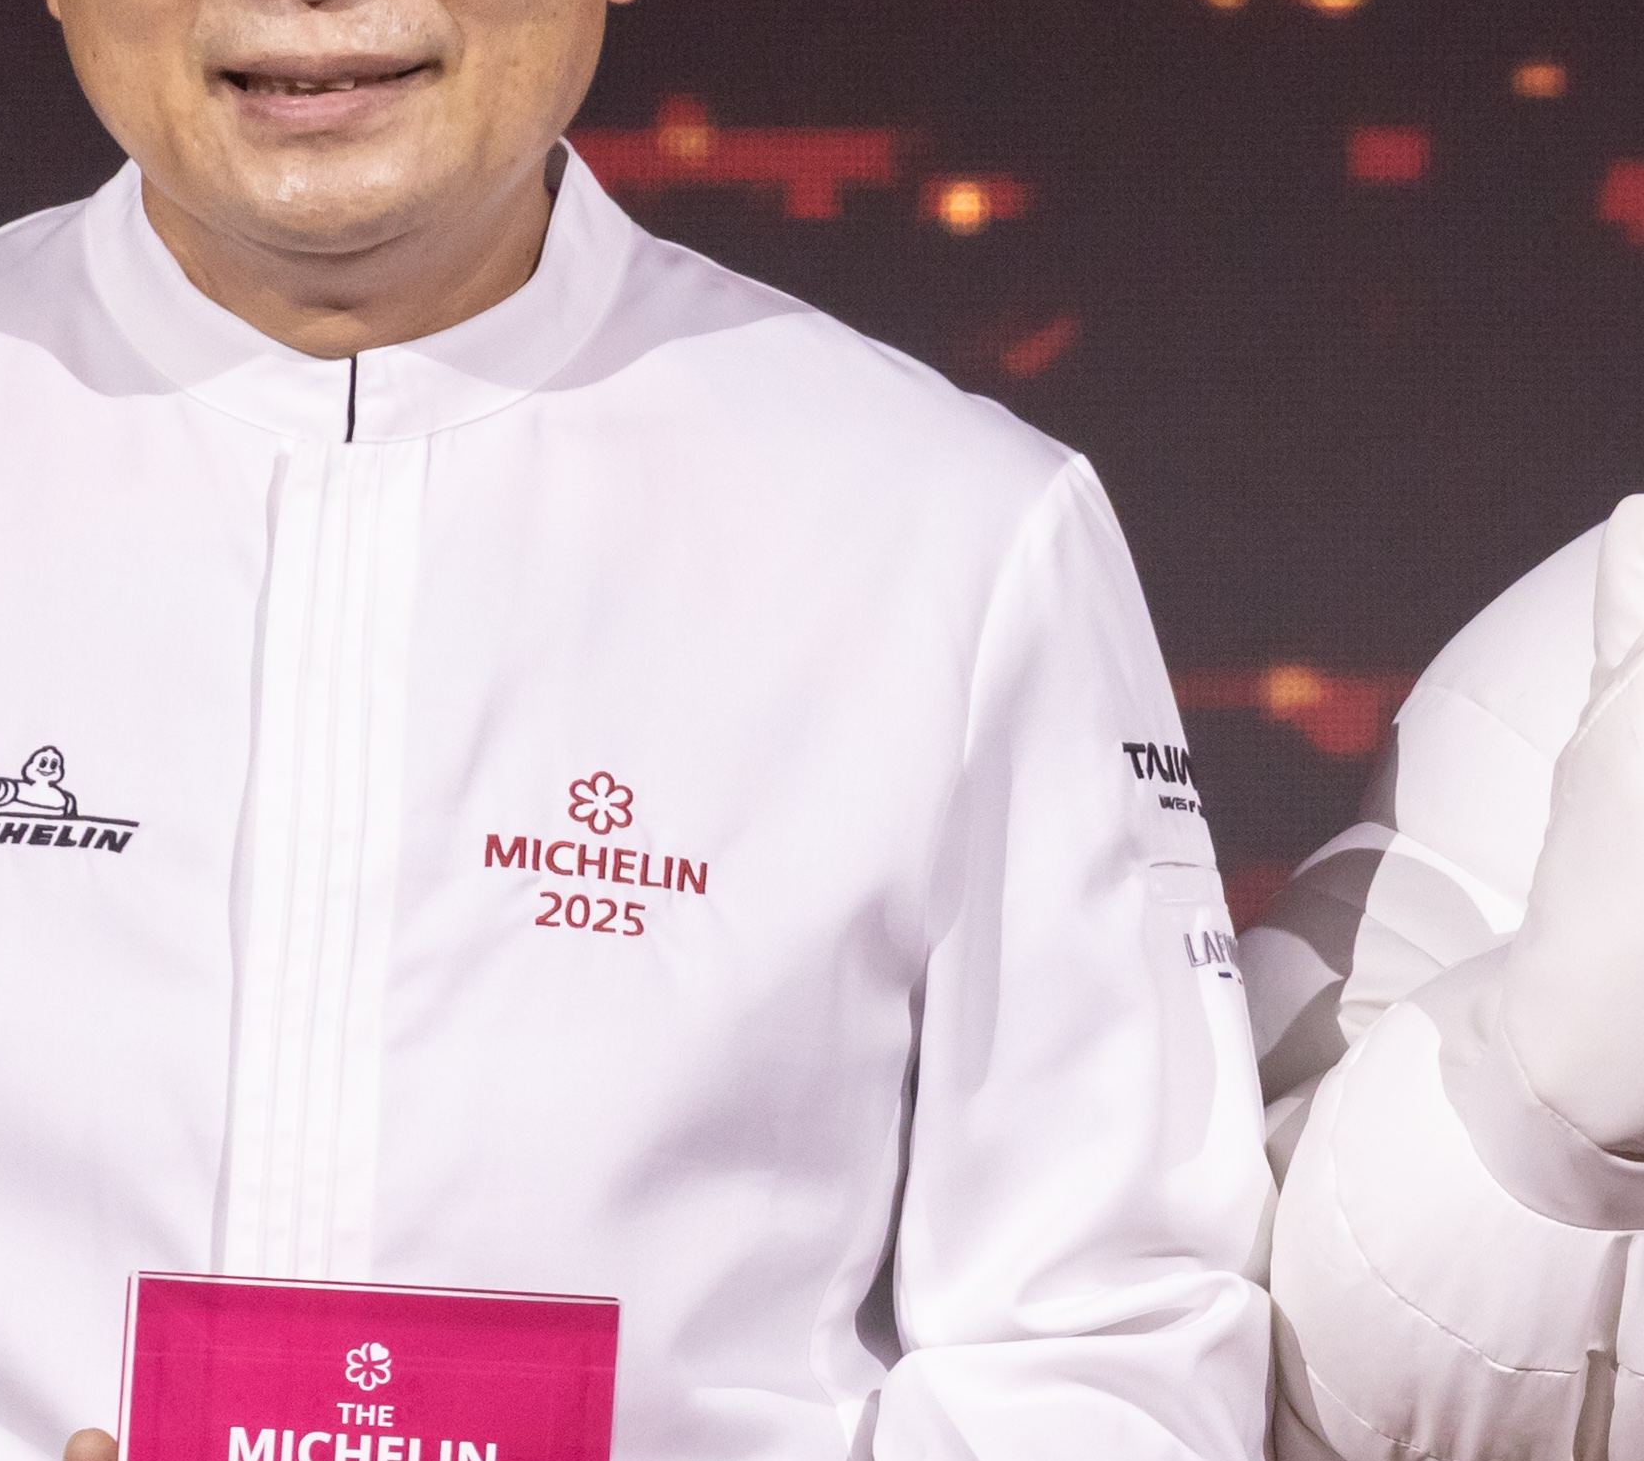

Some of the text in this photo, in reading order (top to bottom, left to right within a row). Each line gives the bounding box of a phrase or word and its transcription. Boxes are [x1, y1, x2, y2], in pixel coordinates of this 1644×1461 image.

[484, 834, 708, 895] MICHELIN
[536, 891, 646, 937] 2025
[336, 1402, 395, 1427] THE
